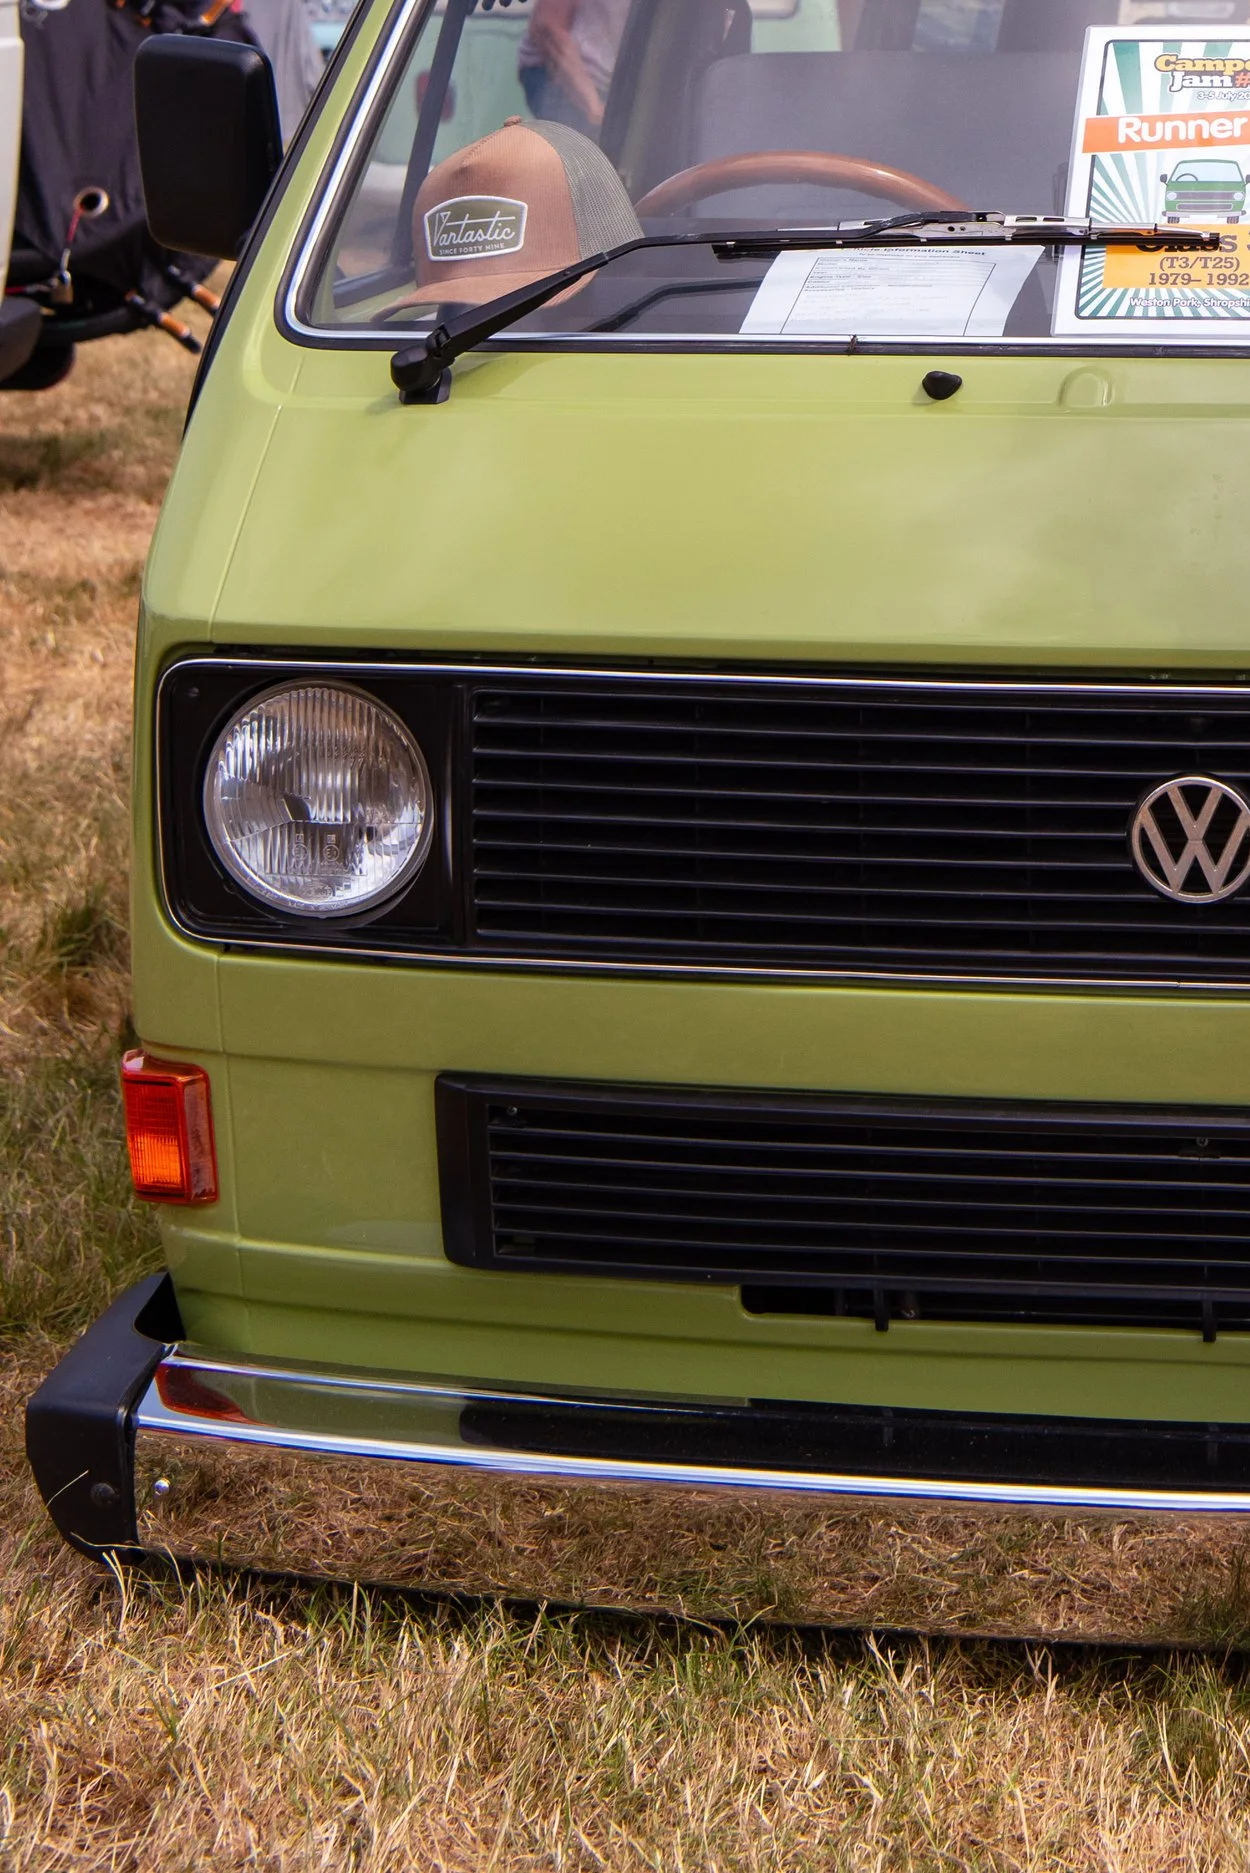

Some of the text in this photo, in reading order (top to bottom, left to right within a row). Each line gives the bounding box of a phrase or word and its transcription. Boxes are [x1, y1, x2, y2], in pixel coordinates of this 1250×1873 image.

[1169, 71, 1233, 92] Jam
[1216, 91, 1239, 102] July
[1117, 116, 1249, 144] Runner
[433, 211, 516, 247] Vantastic
[460, 245, 482, 254] FORTY
[485, 242, 505, 250] NINE
[1159, 256, 1241, 272] (T3/T25)
[1206, 272, 1250, 286] 1992
[1130, 297, 1172, 307] Weston
[1173, 297, 1200, 308] Park,
